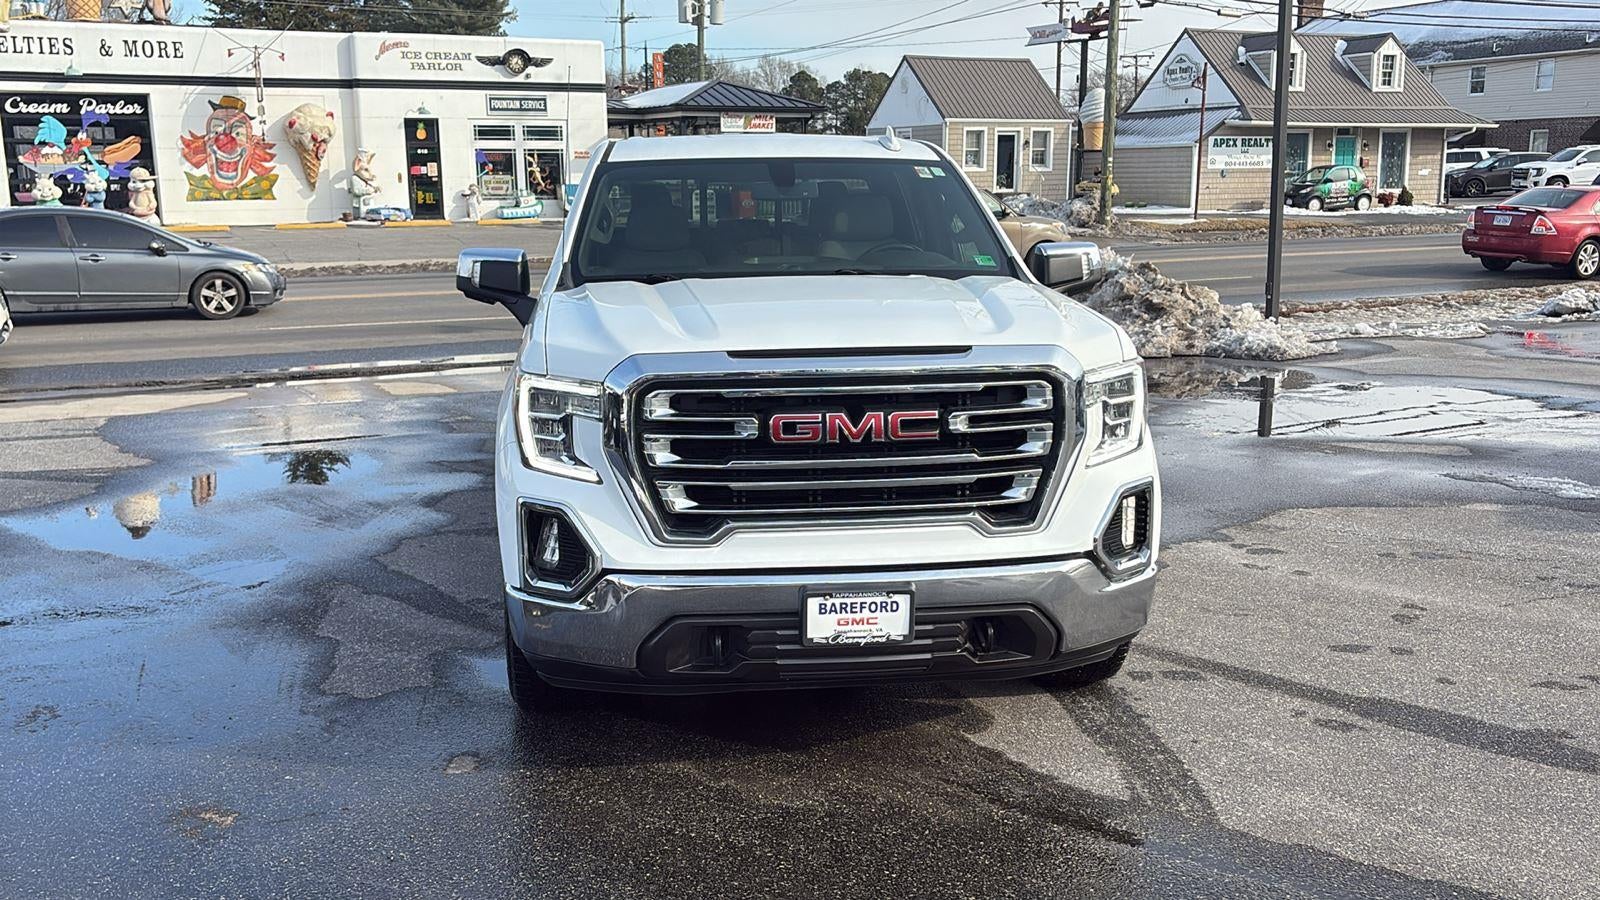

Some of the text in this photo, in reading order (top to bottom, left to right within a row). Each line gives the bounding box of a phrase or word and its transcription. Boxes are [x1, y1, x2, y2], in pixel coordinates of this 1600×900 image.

[0, 35, 184, 59] ELTIES & MORE
[400, 51, 472, 61] ICE CREAM
[410, 62, 463, 71] PARLOR
[4, 96, 145, 115] Cream Parlor
[490, 99, 546, 109] FOUNTAIN SERVICE
[1212, 138, 1273, 148] APEX REALT
[769, 410, 940, 444] GMC
[818, 600, 899, 615] BAREFORD
[836, 617, 878, 626] GMC
